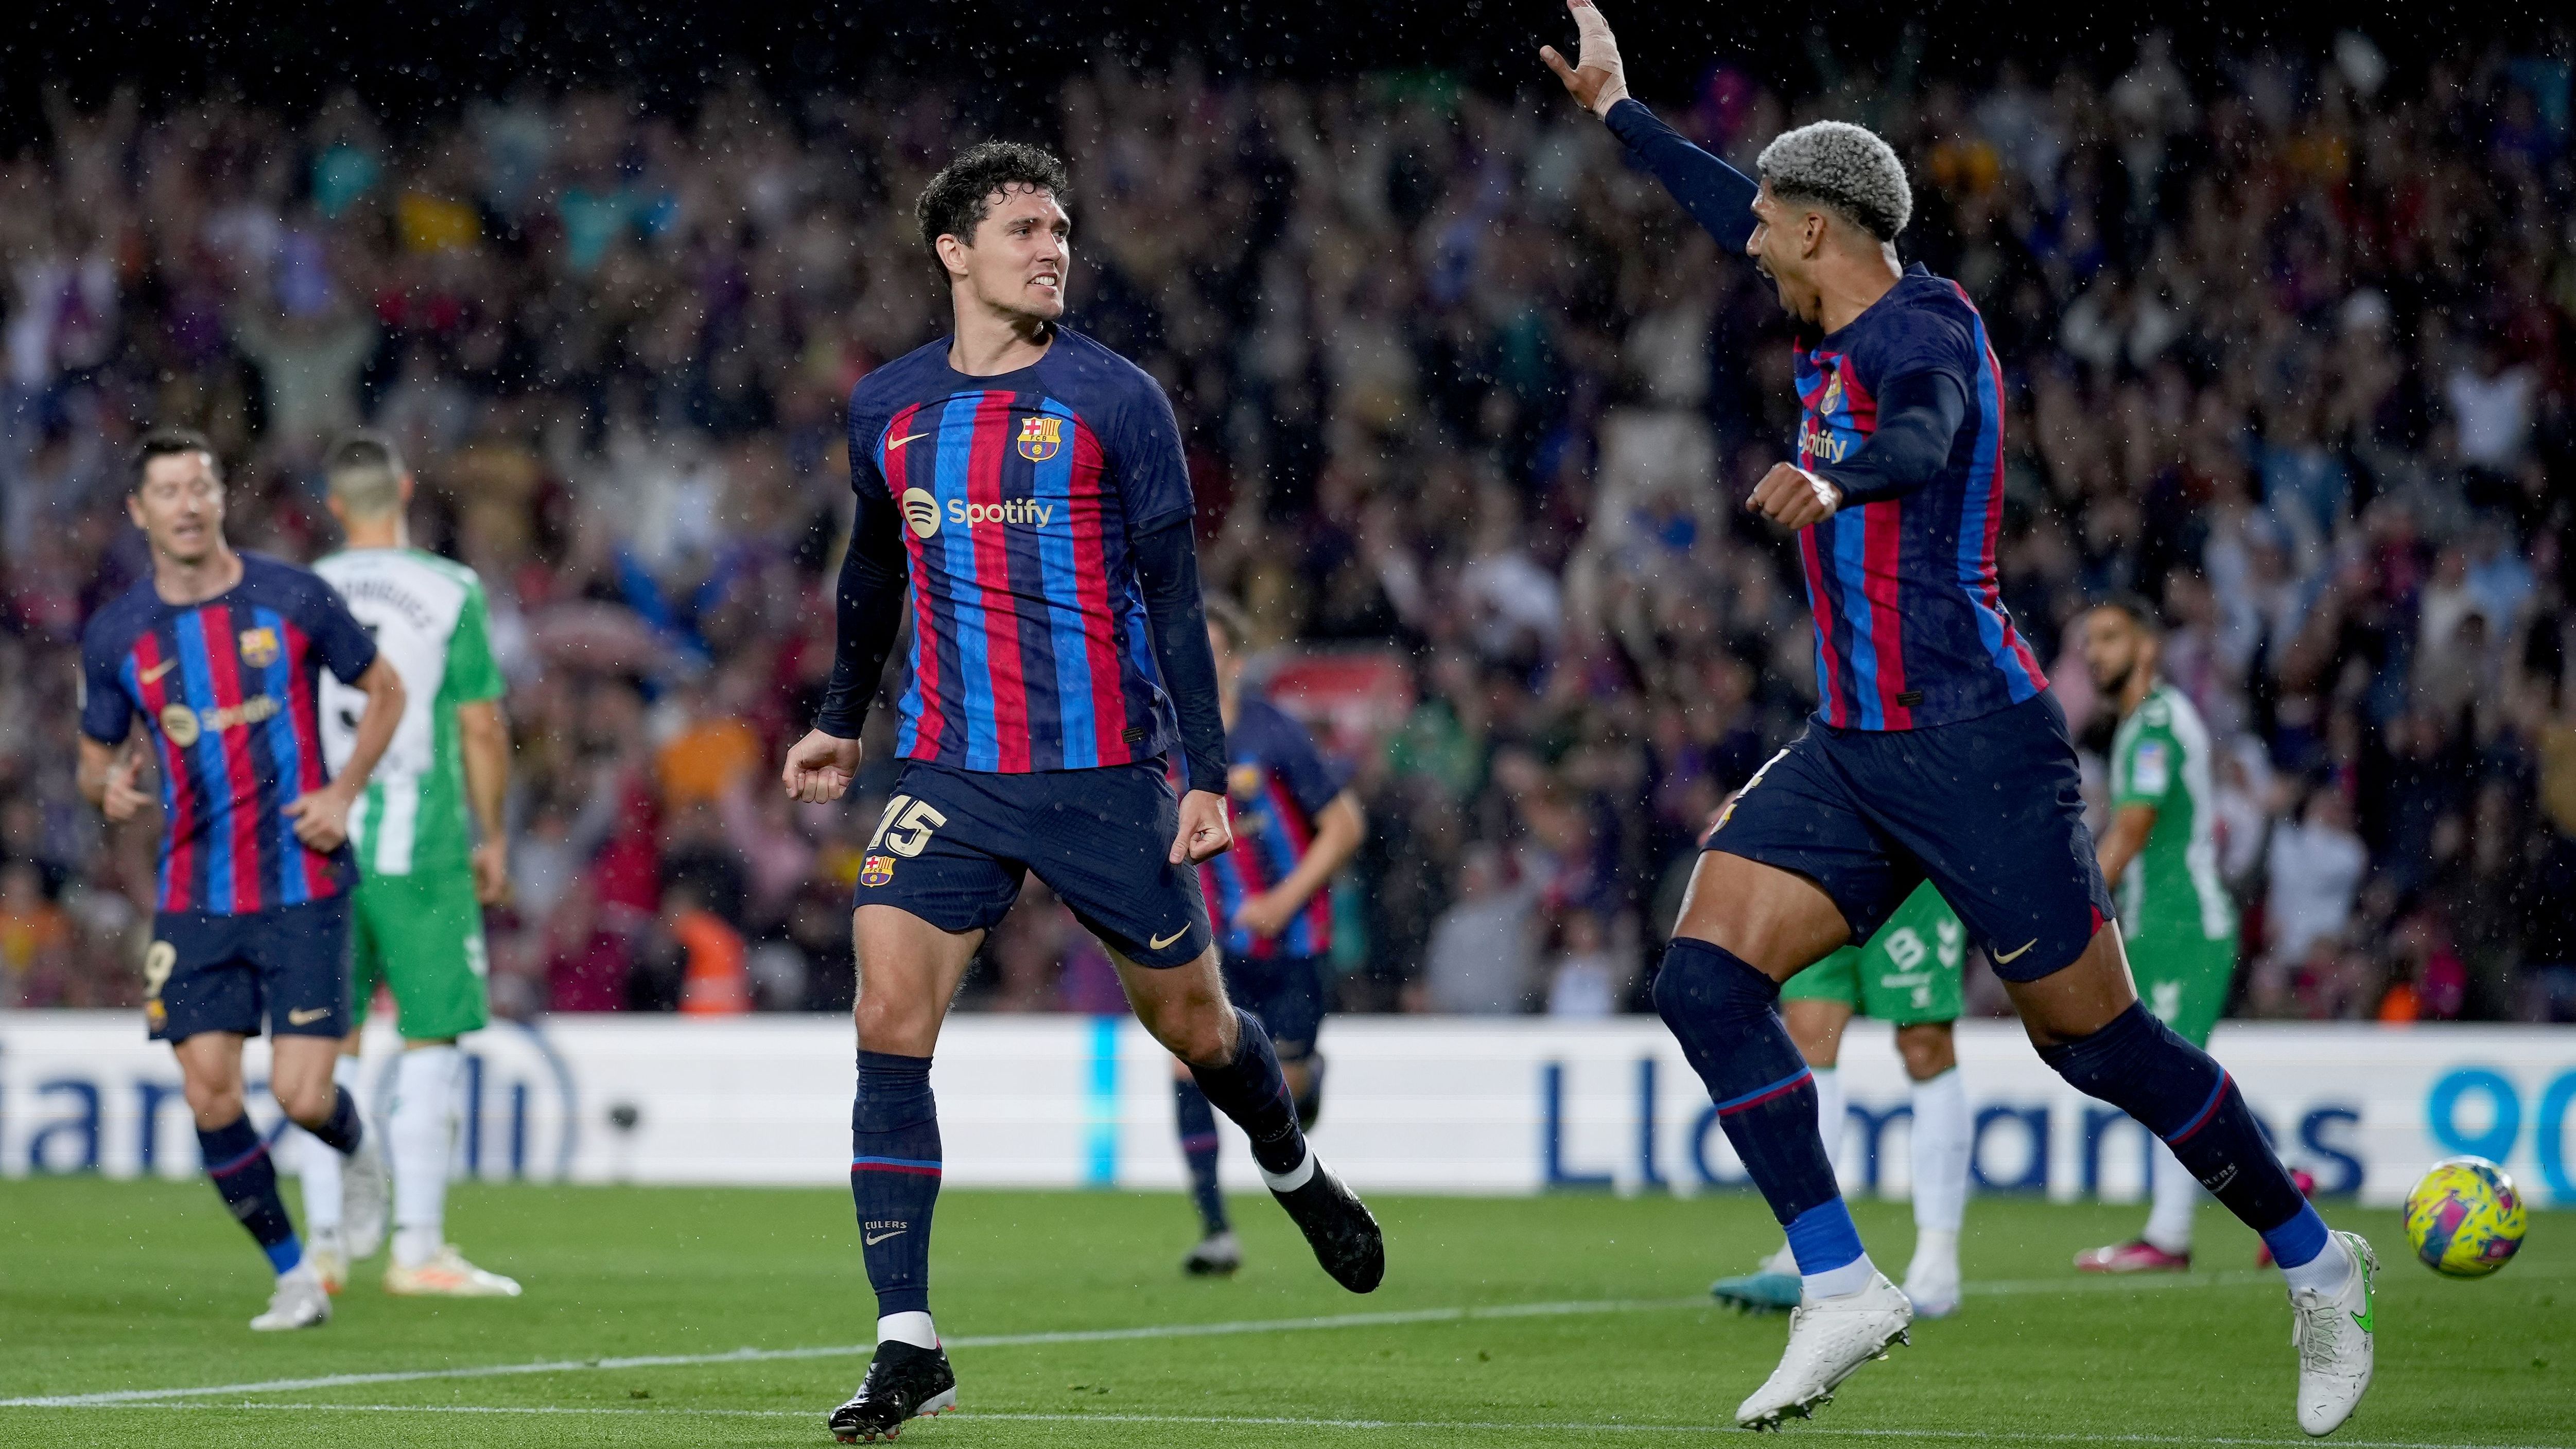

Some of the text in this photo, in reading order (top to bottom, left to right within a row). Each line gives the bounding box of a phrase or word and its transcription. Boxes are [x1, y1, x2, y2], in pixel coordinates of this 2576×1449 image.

[947, 497, 1054, 528] Spotify
[866, 795, 947, 858] 15
[145, 939, 177, 1000] 9
[865, 1220, 908, 1230] CULERS
